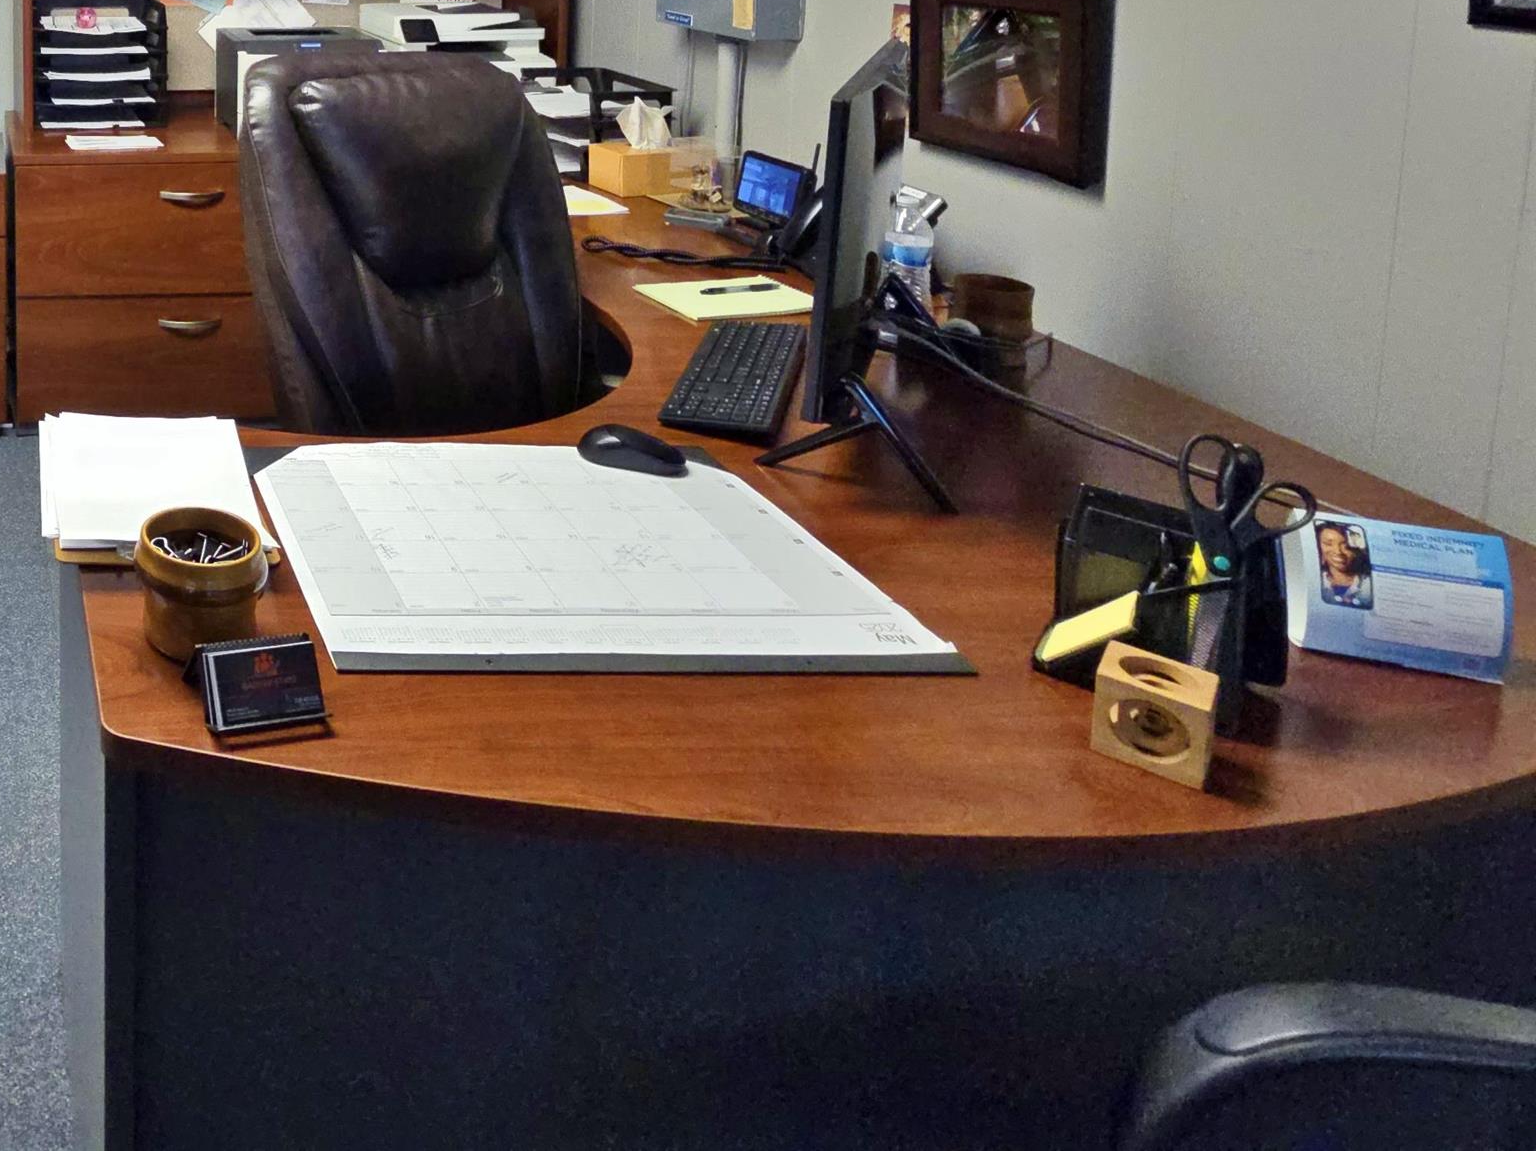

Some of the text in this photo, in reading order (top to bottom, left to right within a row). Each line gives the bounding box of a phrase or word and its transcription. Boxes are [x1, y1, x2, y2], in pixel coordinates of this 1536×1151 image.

[1391, 530, 1424, 541] FIXED
[1393, 538, 1442, 551] MEDICAL
[1444, 545, 1474, 556] PLAN
[875, 633, 917, 646] May
